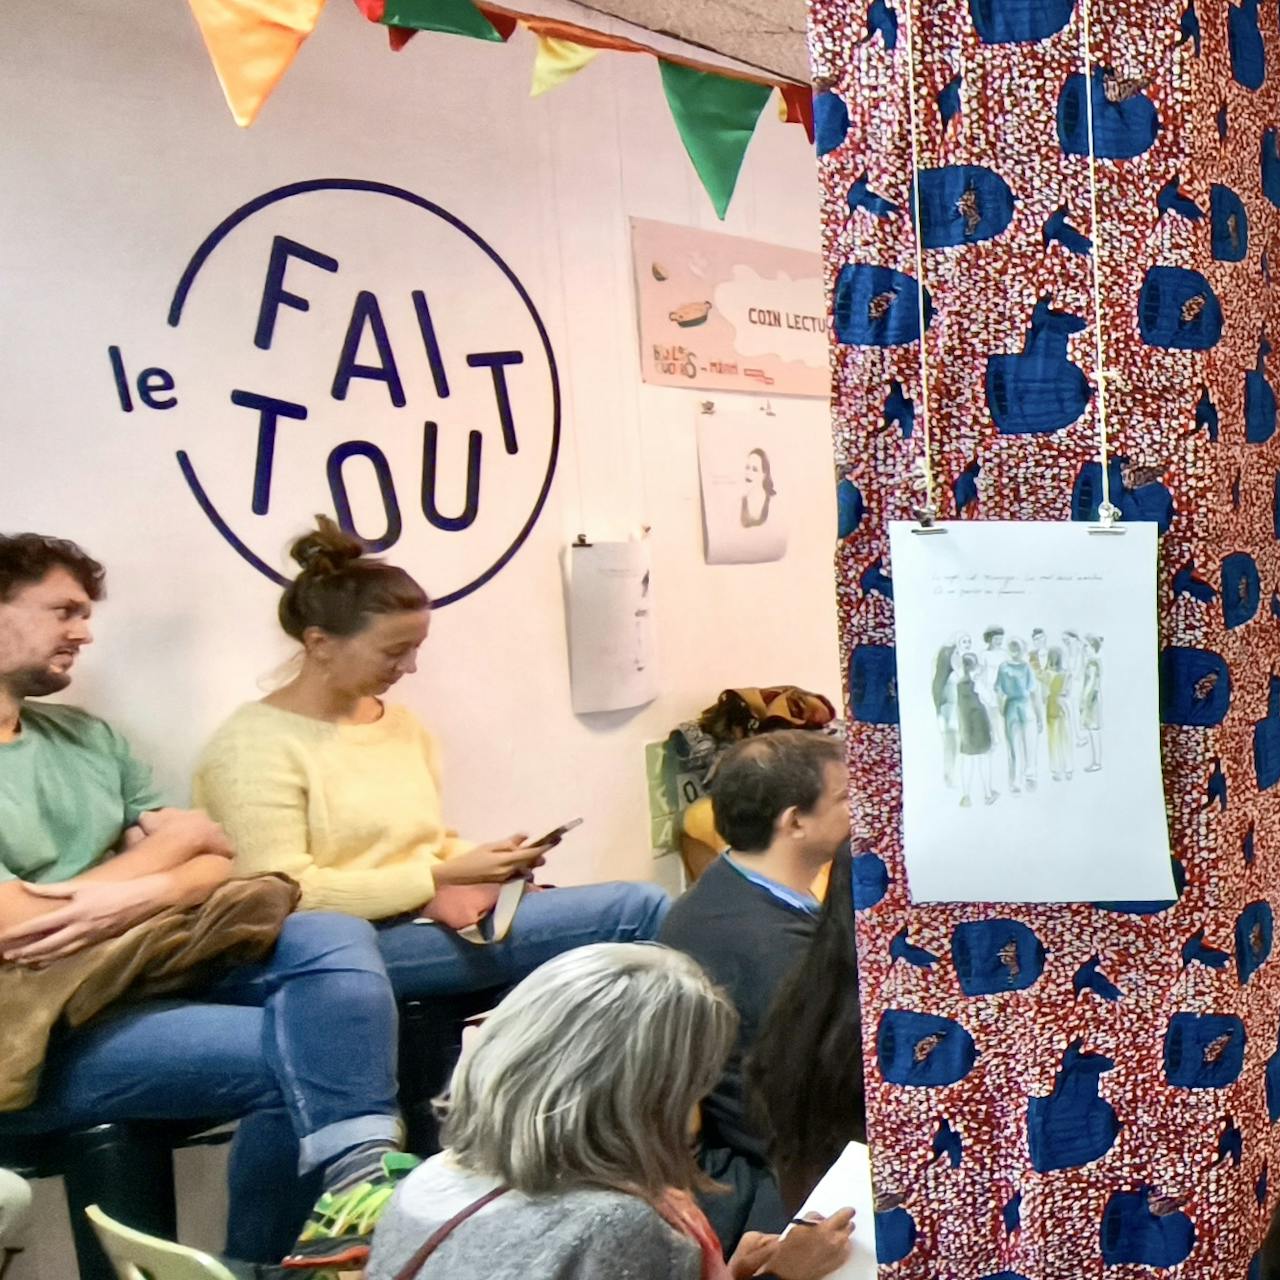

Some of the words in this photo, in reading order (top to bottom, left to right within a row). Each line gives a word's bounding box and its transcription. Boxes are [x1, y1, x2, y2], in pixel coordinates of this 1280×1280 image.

[253, 235, 524, 455] FAIT
[749, 308, 781, 328] COIN
[785, 312, 826, 333] LECTU
[108, 345, 178, 413] le
